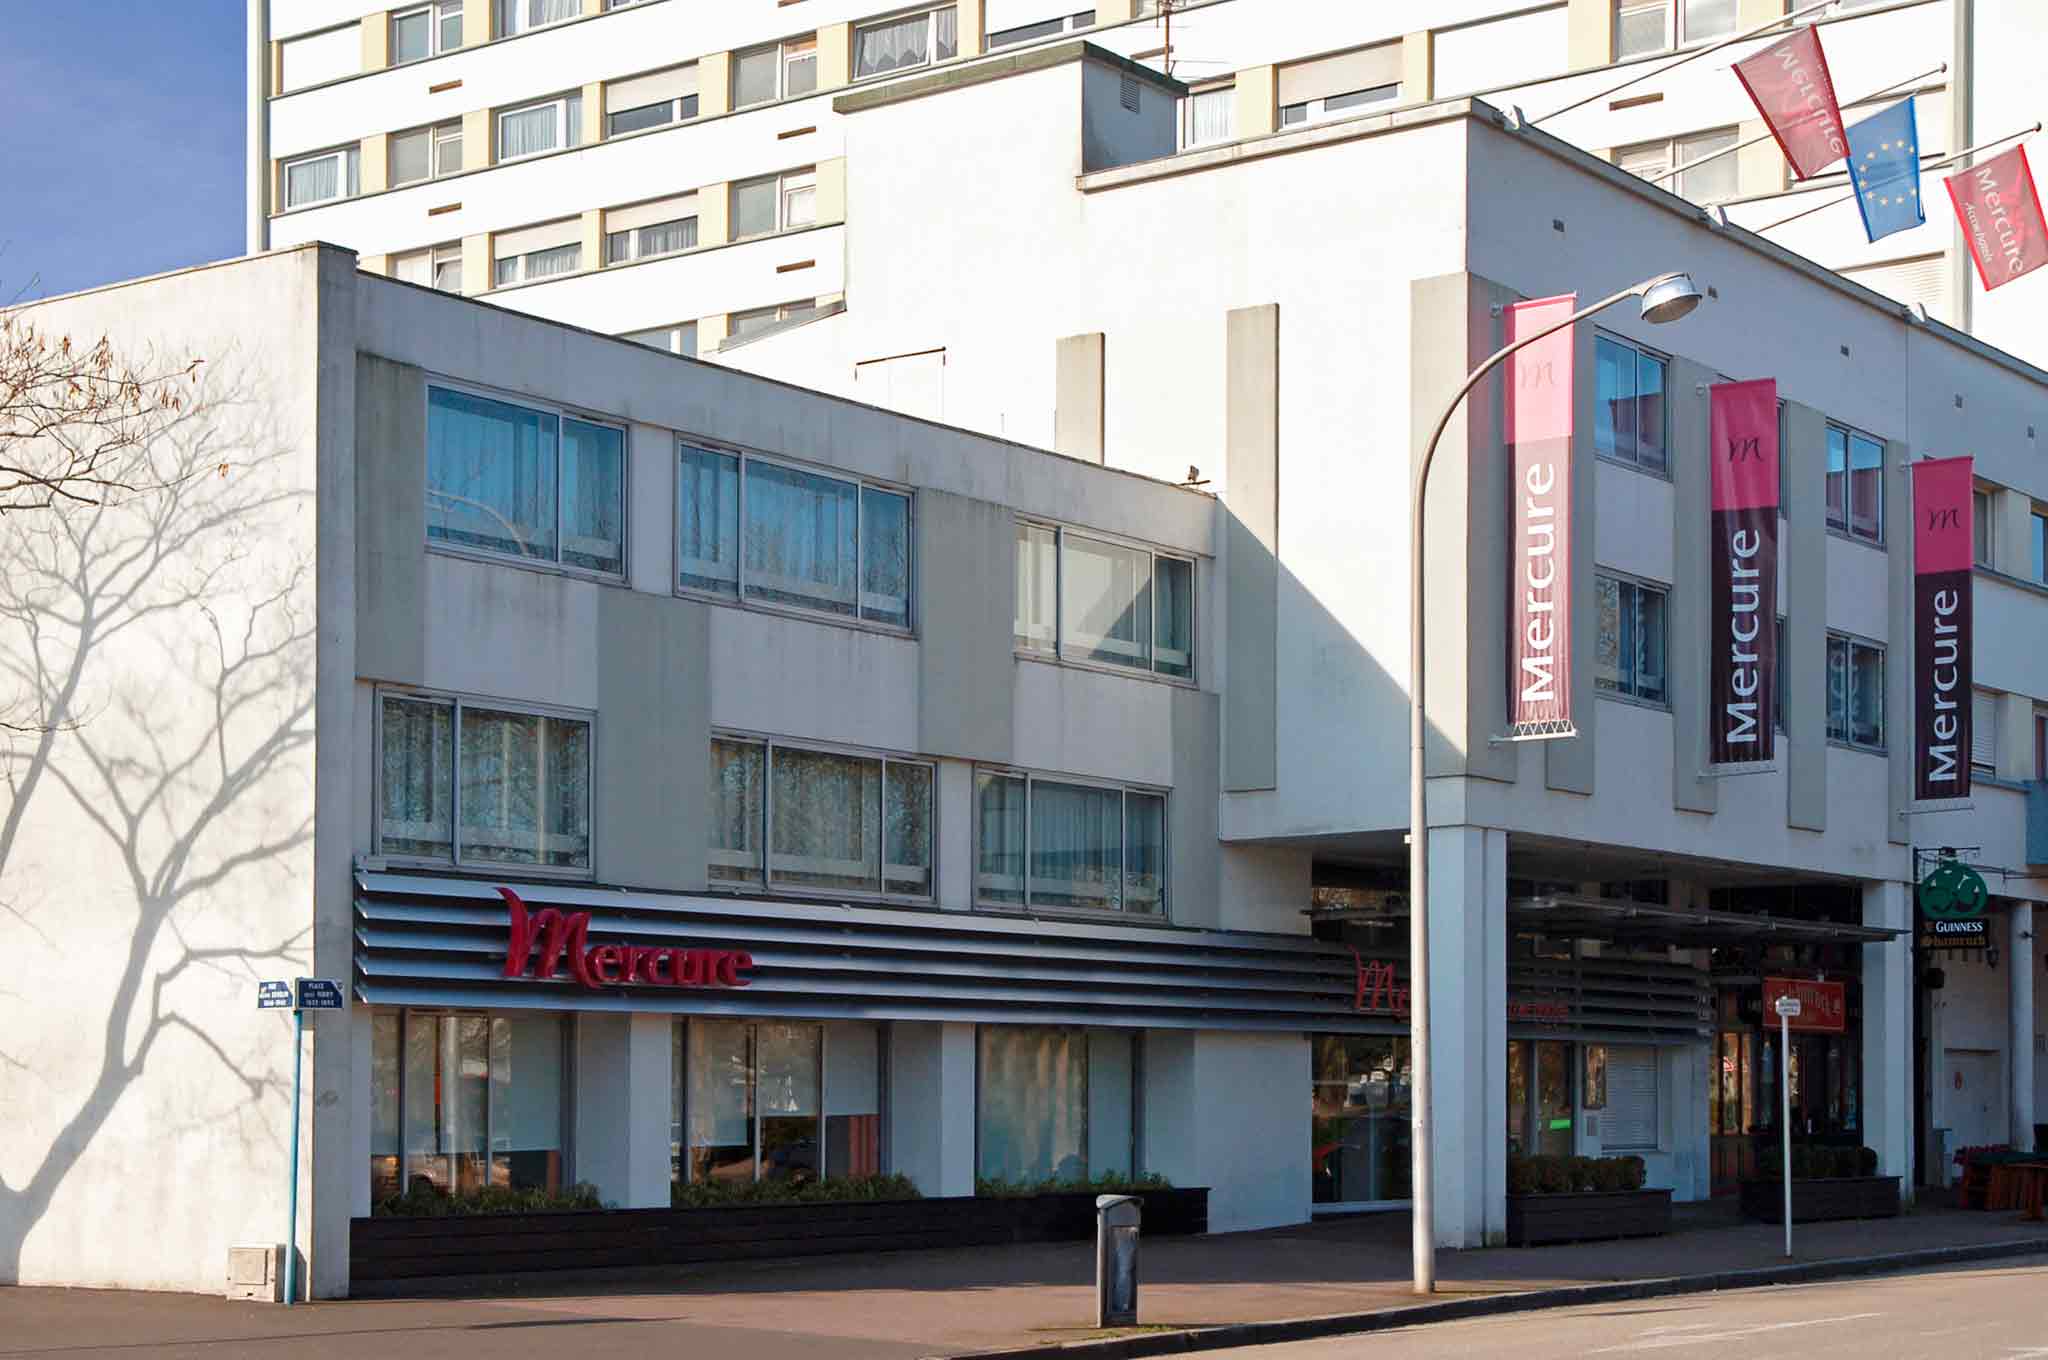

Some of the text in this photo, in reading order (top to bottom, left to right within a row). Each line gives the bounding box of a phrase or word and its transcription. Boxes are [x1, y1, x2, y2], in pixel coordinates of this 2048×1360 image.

[1976, 167, 2023, 273] Mercure
[1520, 462, 1555, 702] Mercure
[1726, 528, 1760, 744] Mercure
[1929, 589, 1958, 781] Mercure
[493, 887, 753, 989] Mercure
[1935, 921, 1984, 933] GUINNESS
